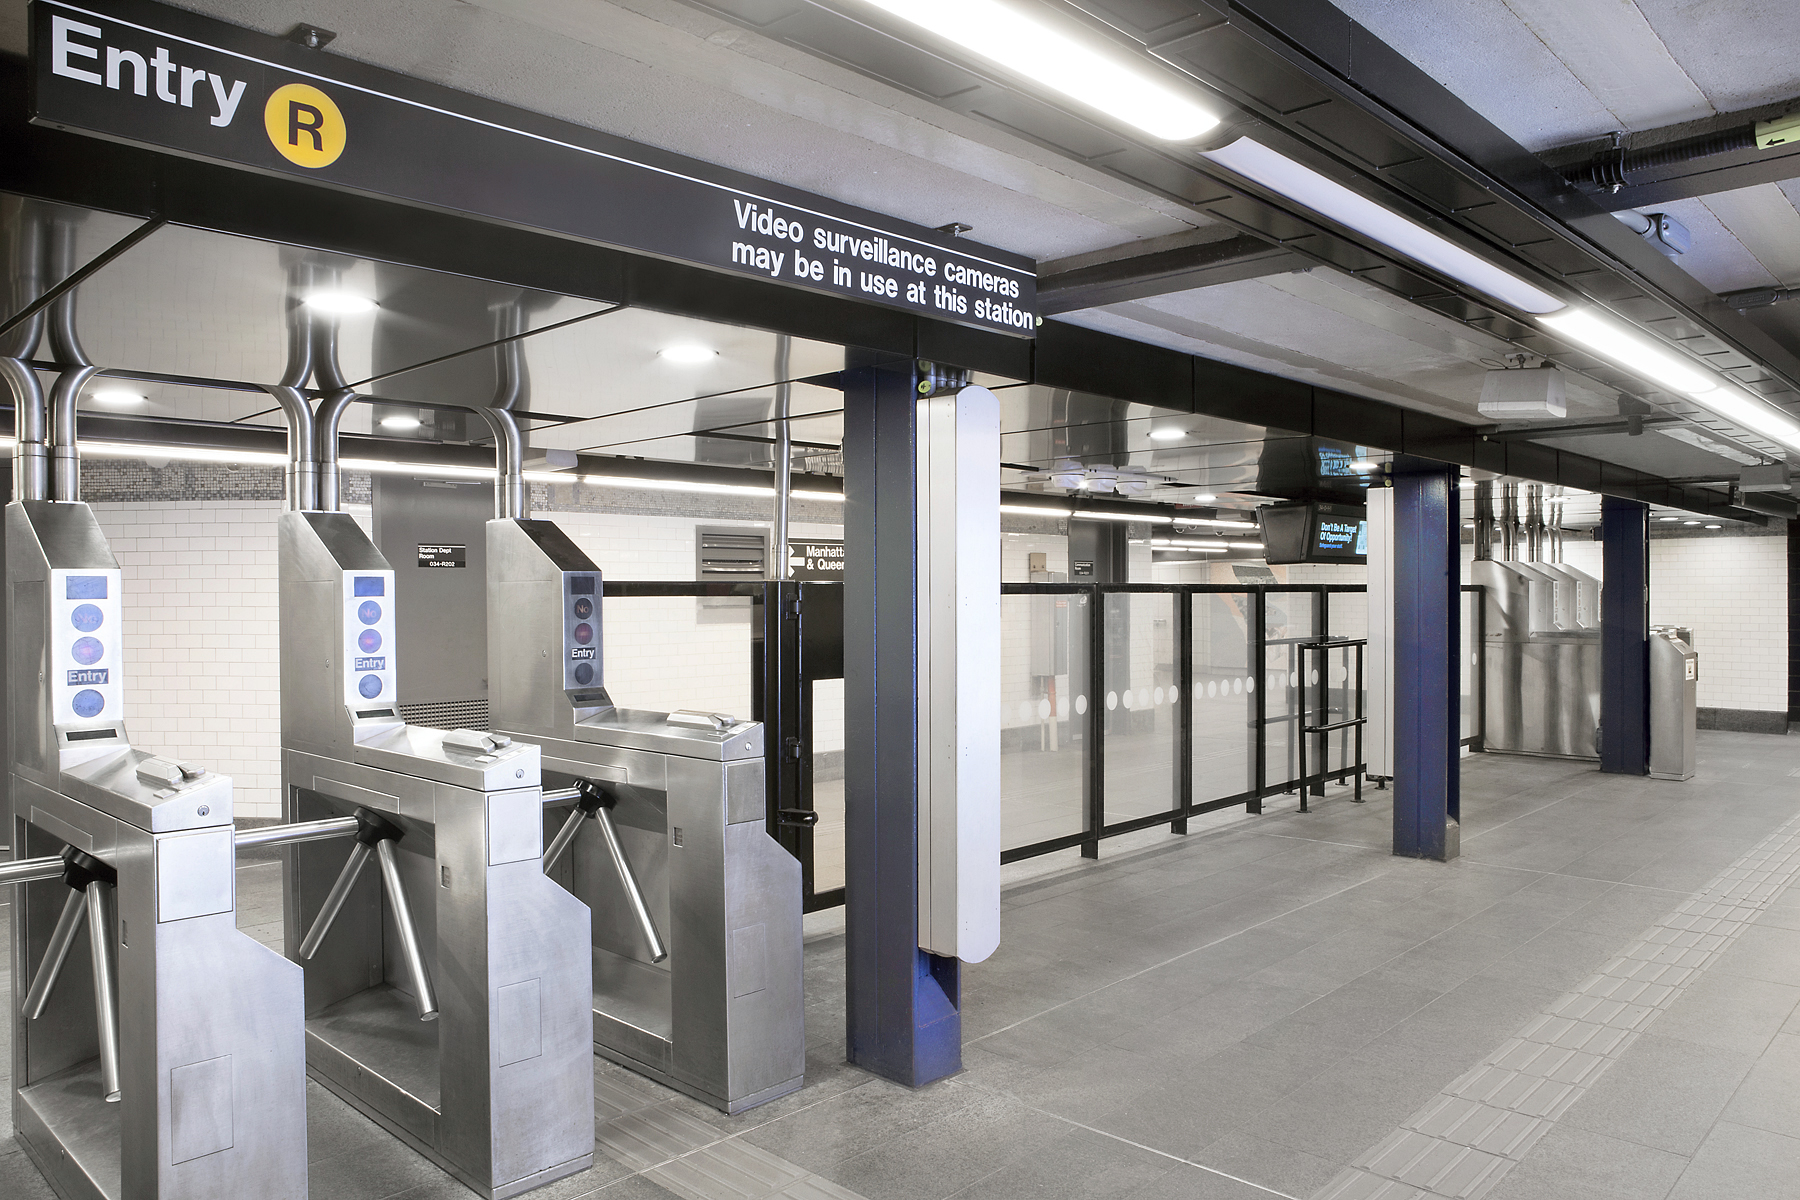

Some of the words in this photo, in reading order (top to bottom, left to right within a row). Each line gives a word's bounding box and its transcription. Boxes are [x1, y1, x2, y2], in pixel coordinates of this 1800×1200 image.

[52, 14, 247, 128] Entry
[288, 99, 324, 152] R
[733, 198, 804, 243] Video
[813, 227, 937, 277] surveillance
[944, 262, 1020, 298] cameras
[732, 241, 785, 277] may
[794, 249, 825, 281] be
[833, 258, 852, 288] in
[860, 271, 899, 298] use
[906, 281, 927, 305] at
[934, 284, 968, 315] this
[974, 297, 1034, 330] station
[1333, 523, 1340, 532] Be
[1344, 524, 1357, 534] Target
[806, 558, 815, 570] &
[361, 608, 377, 618] No
[577, 604, 589, 613] No
[571, 648, 595, 659] Entry
[355, 658, 384, 669] Entry
[68, 670, 107, 683] Entry
